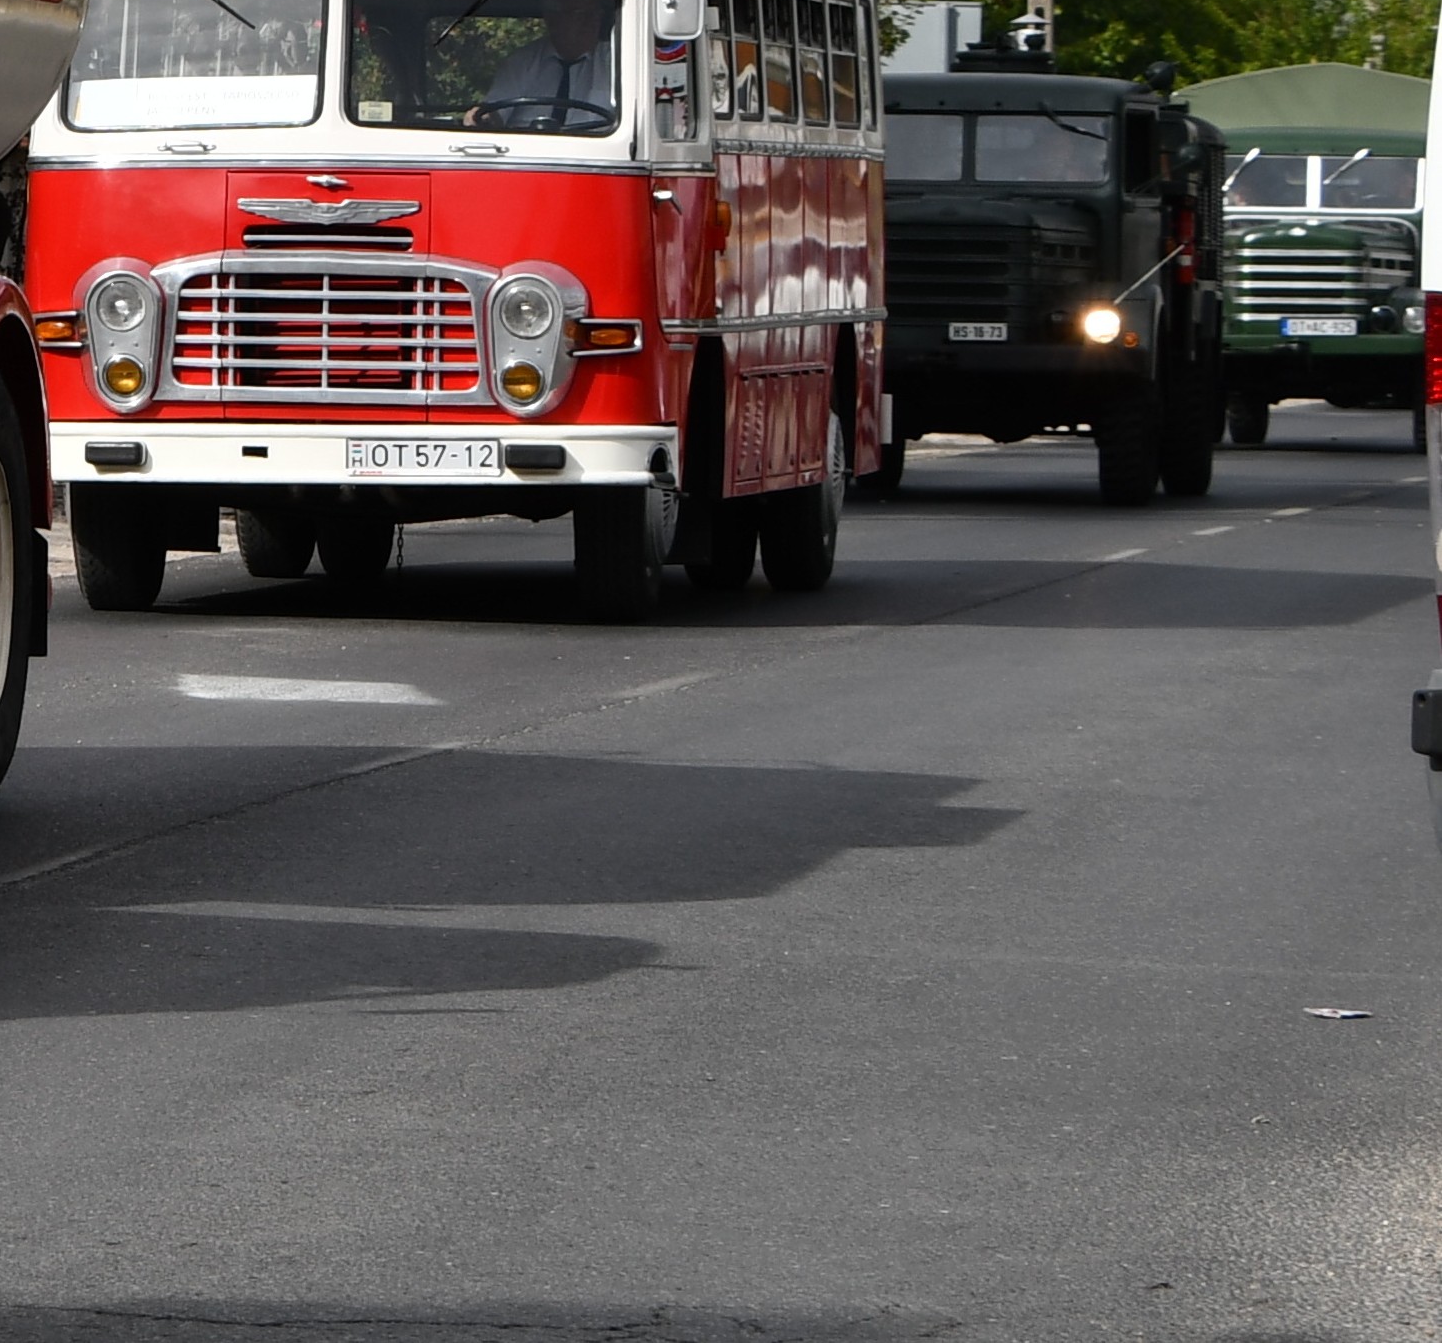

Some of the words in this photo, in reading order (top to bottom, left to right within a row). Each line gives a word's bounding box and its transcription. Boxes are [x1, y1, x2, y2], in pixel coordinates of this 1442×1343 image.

[352, 457, 363, 467] H
[371, 444, 409, 467] OT
[415, 444, 493, 467] 57-12
